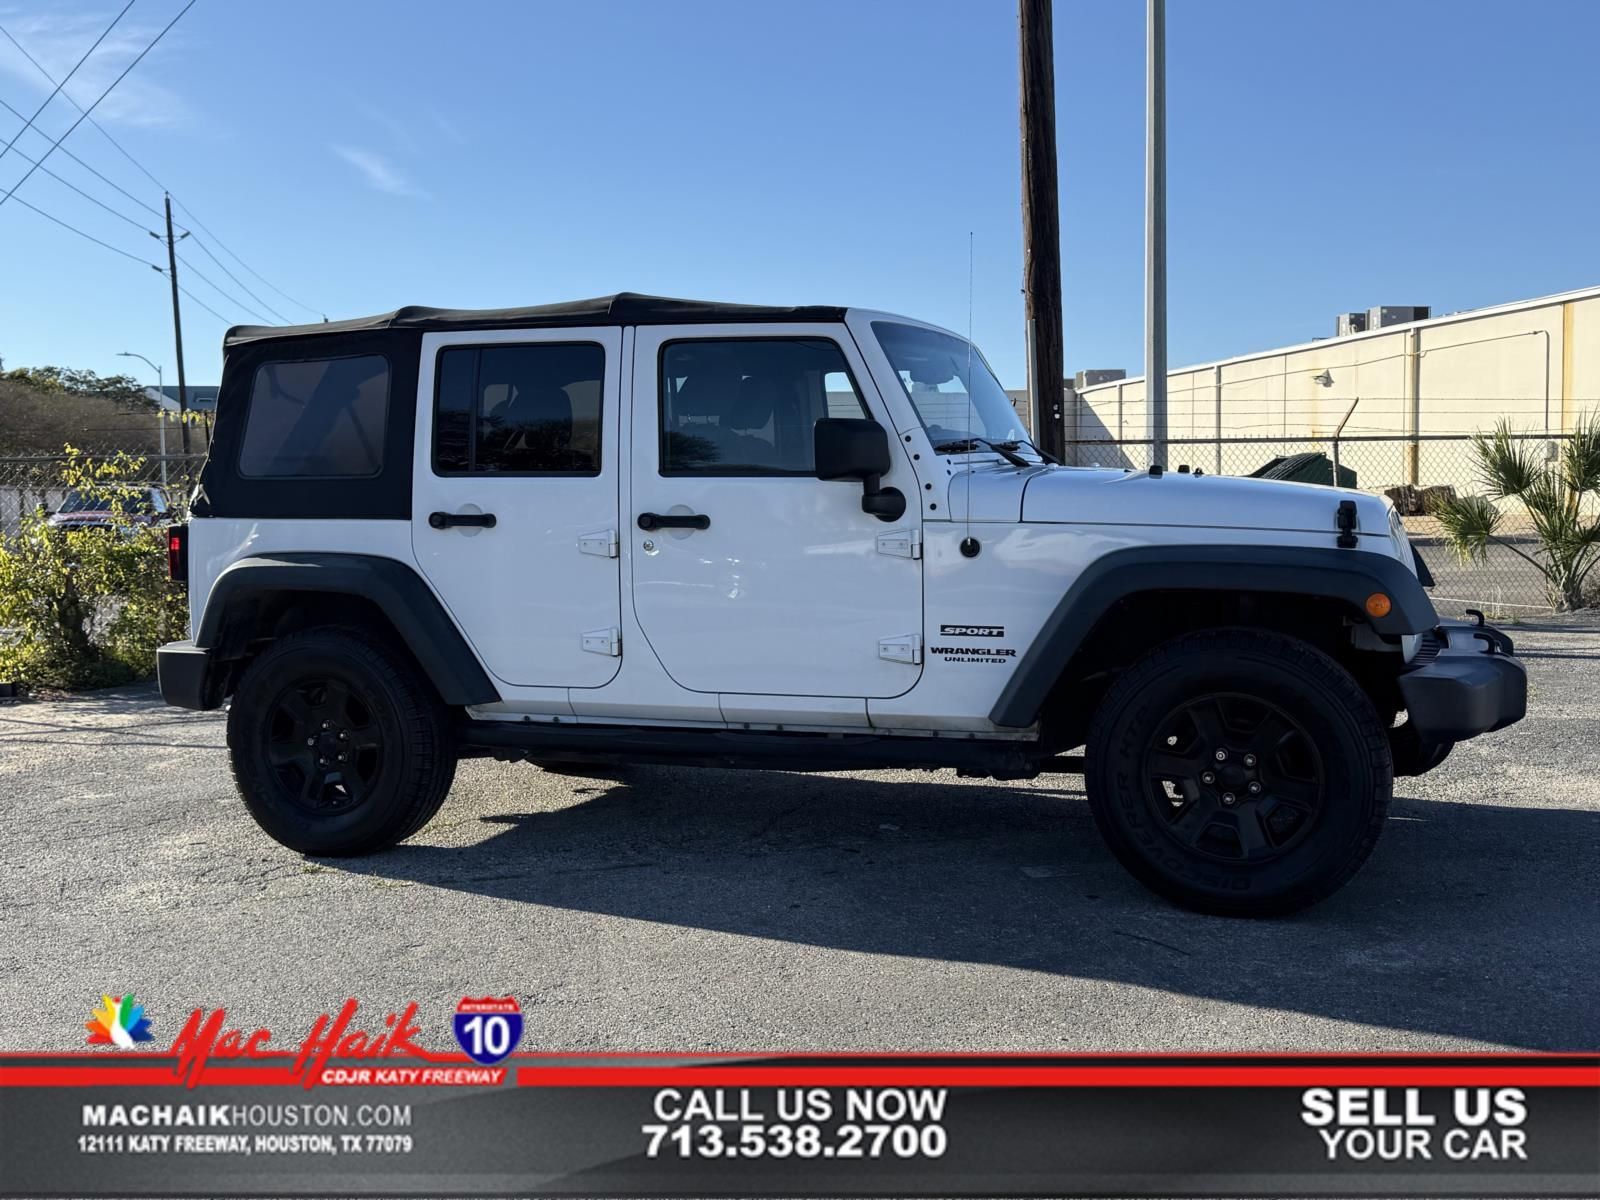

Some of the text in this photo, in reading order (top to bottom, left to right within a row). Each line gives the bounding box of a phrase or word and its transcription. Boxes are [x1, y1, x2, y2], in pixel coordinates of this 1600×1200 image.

[942, 627, 1003, 636] SPORT
[930, 647, 1017, 657] WRANGLER
[944, 656, 1006, 664] UNLIMITED
